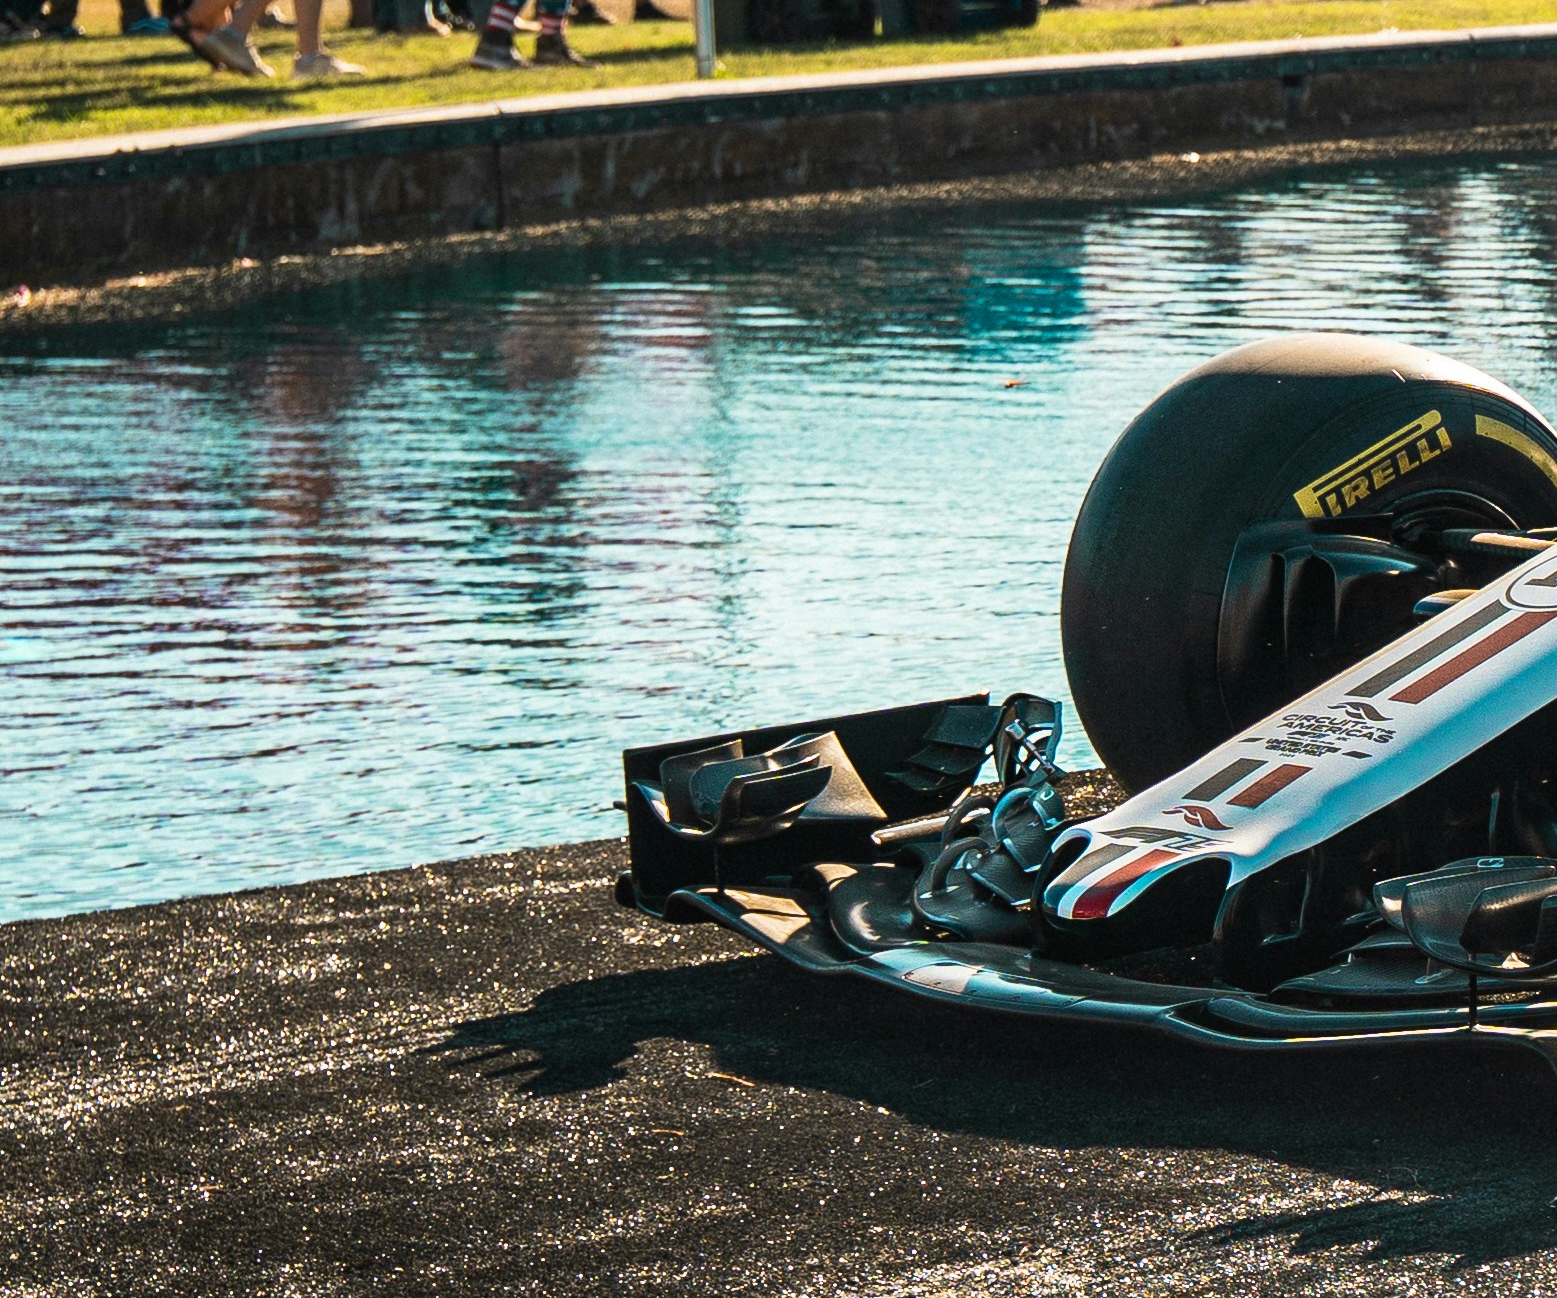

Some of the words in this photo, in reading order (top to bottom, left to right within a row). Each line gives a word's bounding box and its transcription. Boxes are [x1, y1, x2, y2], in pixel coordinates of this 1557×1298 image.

[1293, 408, 1453, 519] PIRELLI
[1276, 721, 1394, 744] AMERICAS
[1281, 713, 1367, 728] CIRCUIT
[1374, 726, 1397, 736] THE
